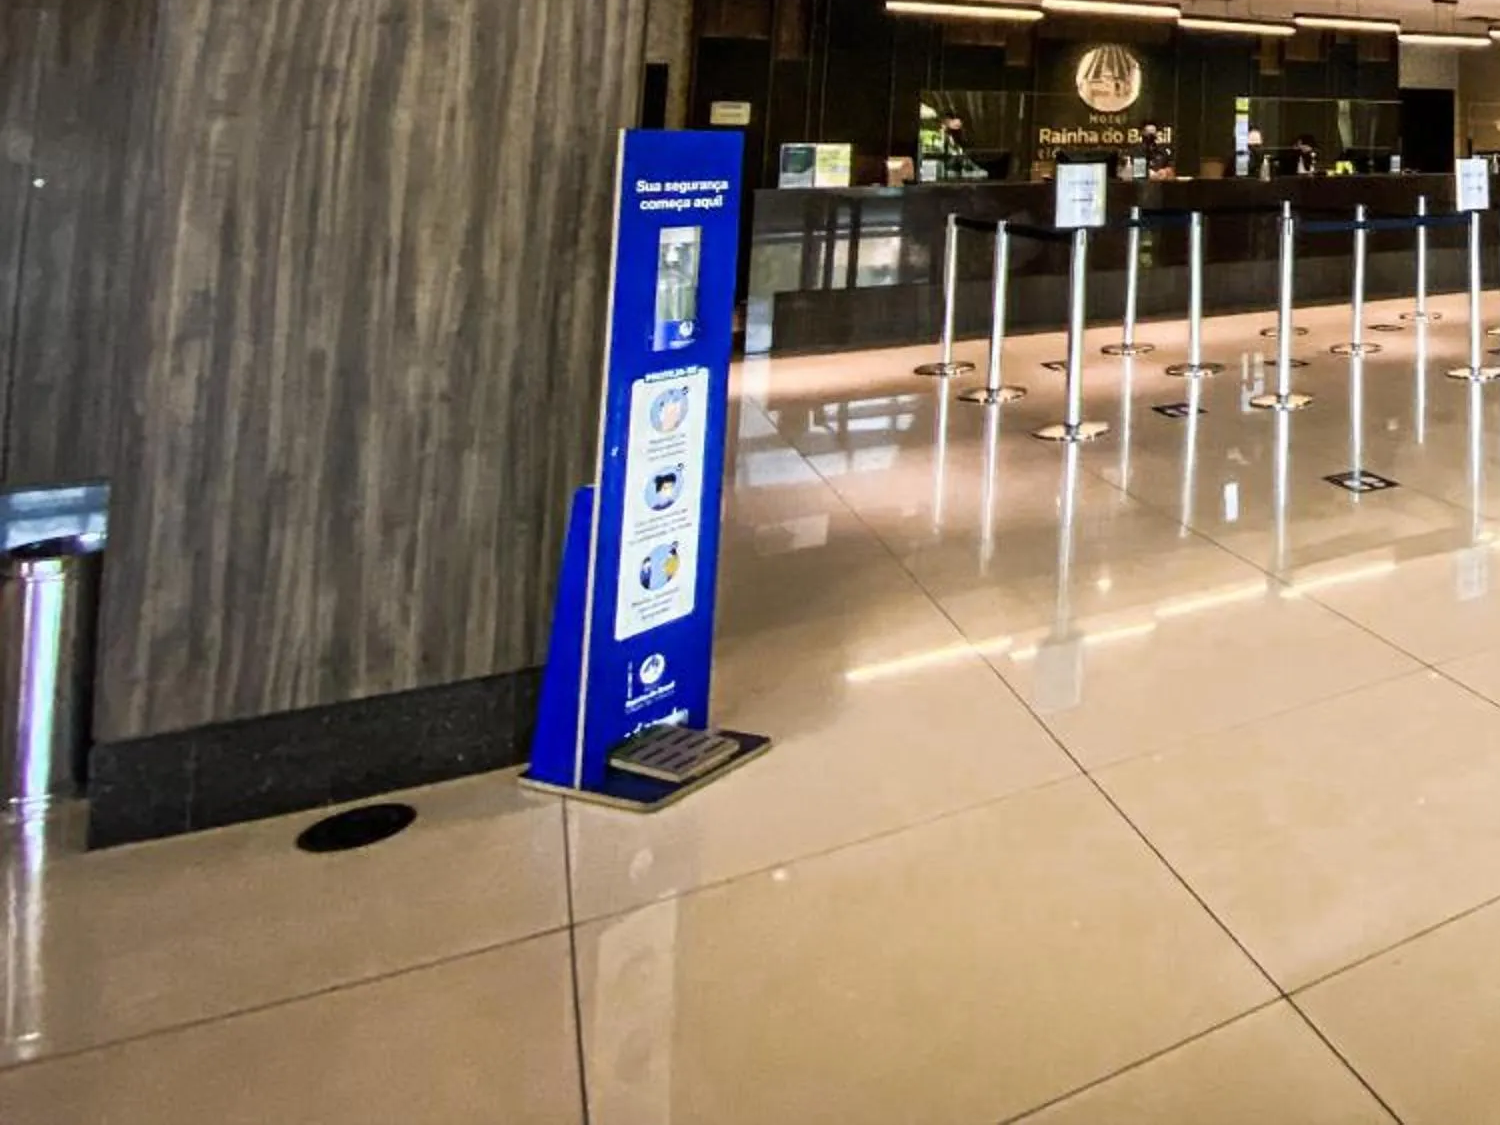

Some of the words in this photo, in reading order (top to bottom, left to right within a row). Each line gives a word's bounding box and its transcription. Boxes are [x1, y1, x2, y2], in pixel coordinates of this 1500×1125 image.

[1039, 127, 1099, 144] Rainha
[1102, 127, 1124, 144] do
[1127, 126, 1172, 144] Bsil
[636, 179, 662, 193] Sua
[664, 179, 729, 194] segurança
[640, 197, 691, 212] começa
